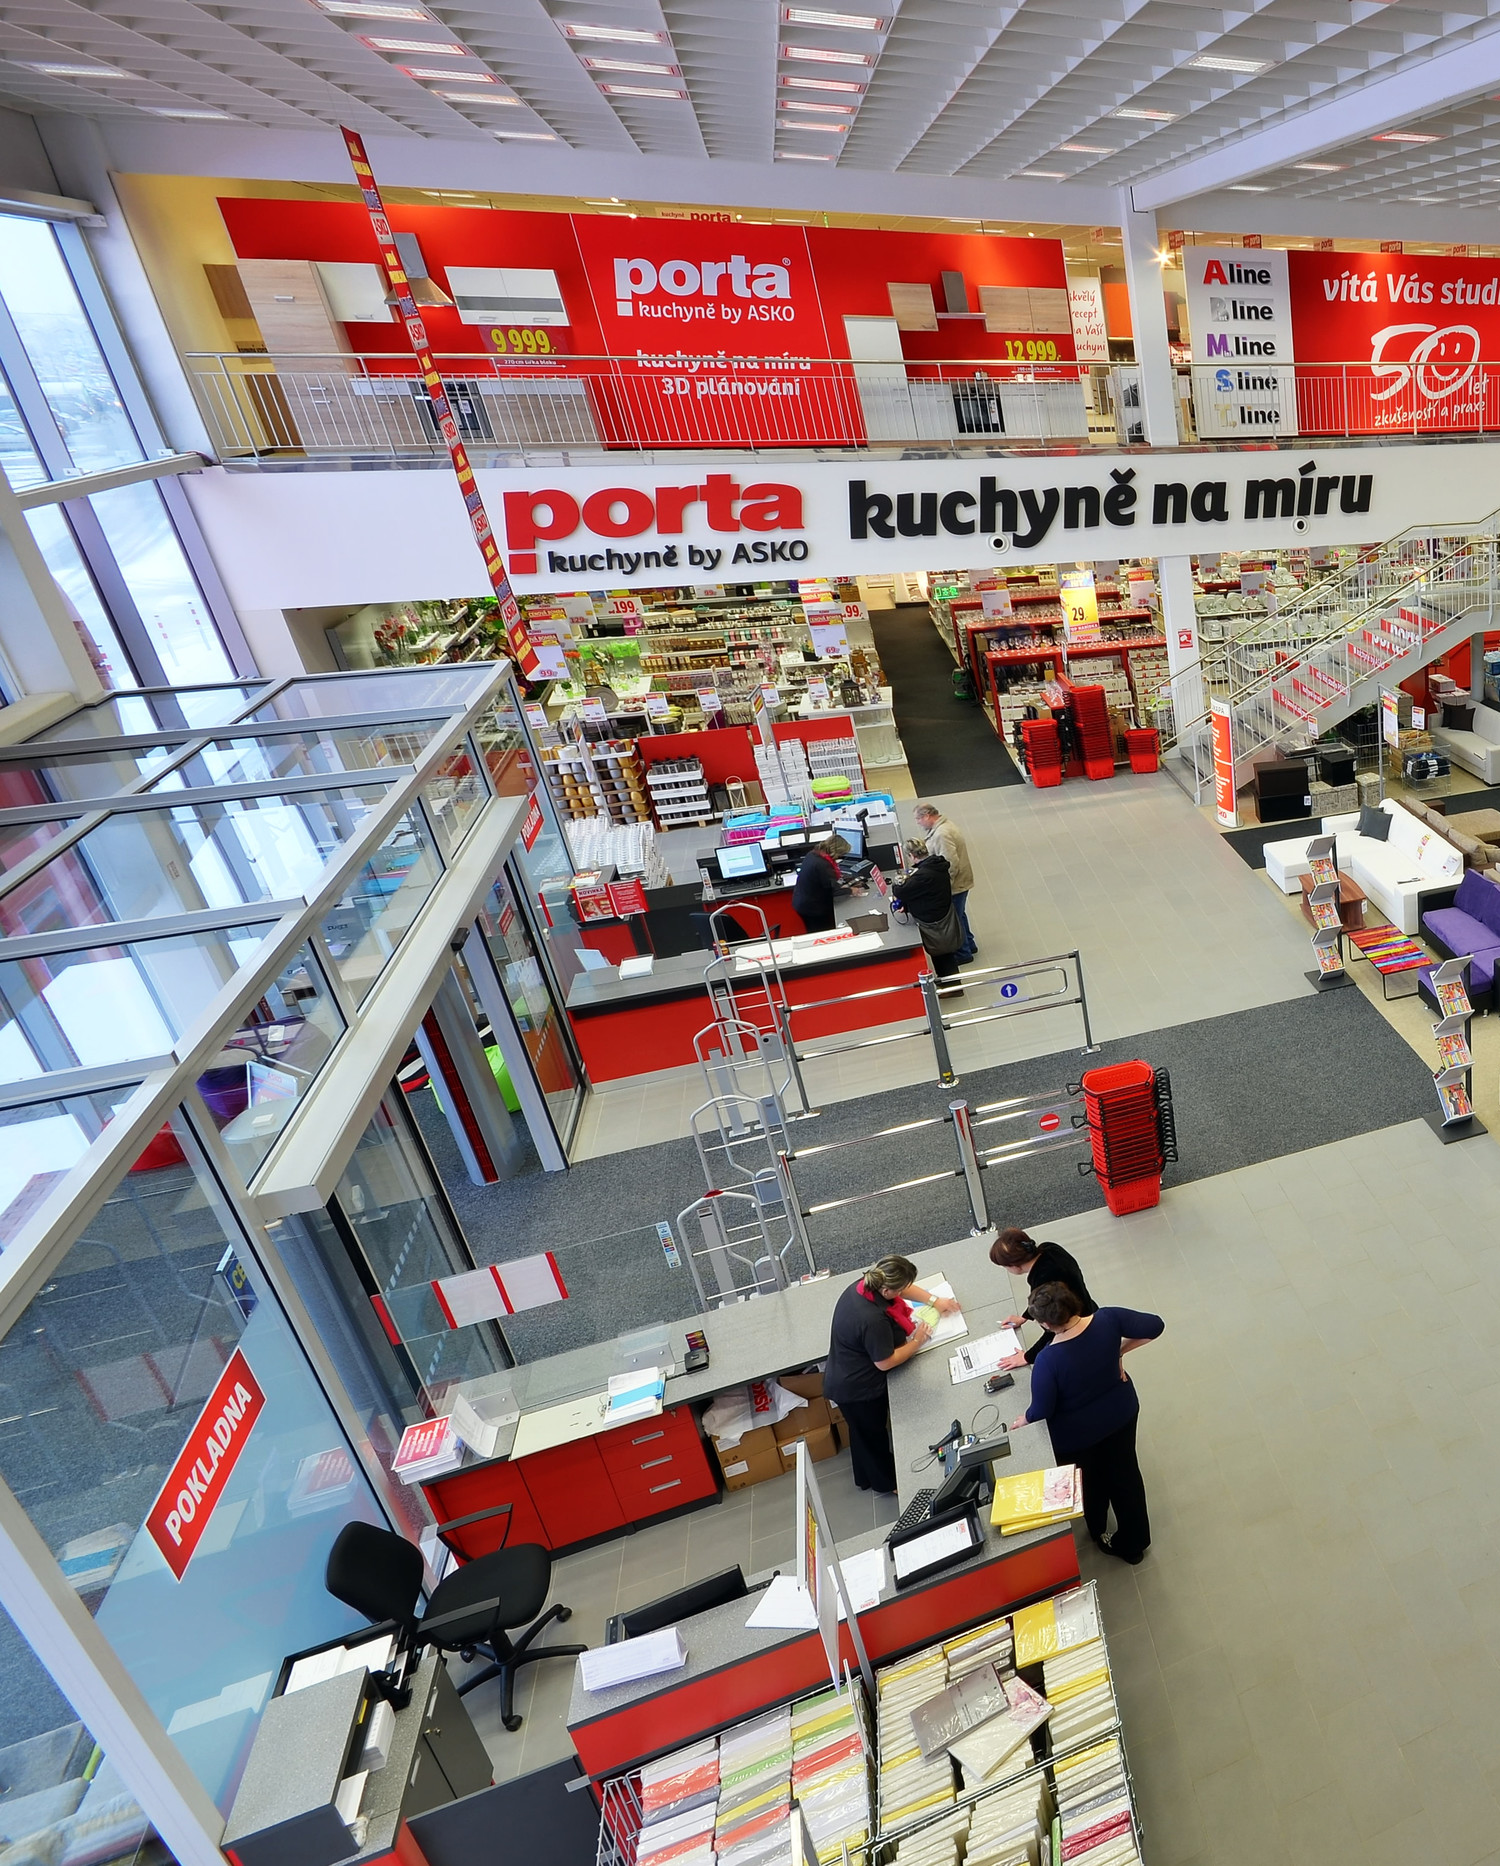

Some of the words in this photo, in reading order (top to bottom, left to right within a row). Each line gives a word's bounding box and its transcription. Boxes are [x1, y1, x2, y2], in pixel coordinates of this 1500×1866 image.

[690, 211, 731, 223] porta
[613, 254, 792, 300] porta
[1323, 271, 1377, 302] vítá
[1387, 273, 1434, 304] Vás
[639, 302, 716, 323] kuchyně
[721, 304, 742, 324] by
[748, 305, 795, 321] ASKO
[1076, 340, 1106, 355] uchyni
[637, 349, 727, 373] kuchyně
[733, 355, 760, 371] na
[764, 352, 811, 370] míru
[662, 377, 690, 395] 3D
[696, 377, 800, 399] plánování
[1469, 373, 1489, 395] let
[1441, 406, 1449, 417] a
[1454, 400, 1485, 421] praxe
[503, 473, 805, 550] porta
[848, 467, 1138, 549] kuchyně
[1152, 480, 1228, 525] na
[1244, 459, 1373, 520] míru
[549, 545, 678, 575] kuchyně
[688, 545, 721, 570] by
[732, 539, 809, 565] ASKO
[613, 600, 639, 613] 199,-
[1071, 606, 1088, 622] 29,-
[521, 803, 542, 842] POKLADNA
[578, 887, 605, 897] NOVINKA
[165, 1382, 252, 1547] POKLADNA
